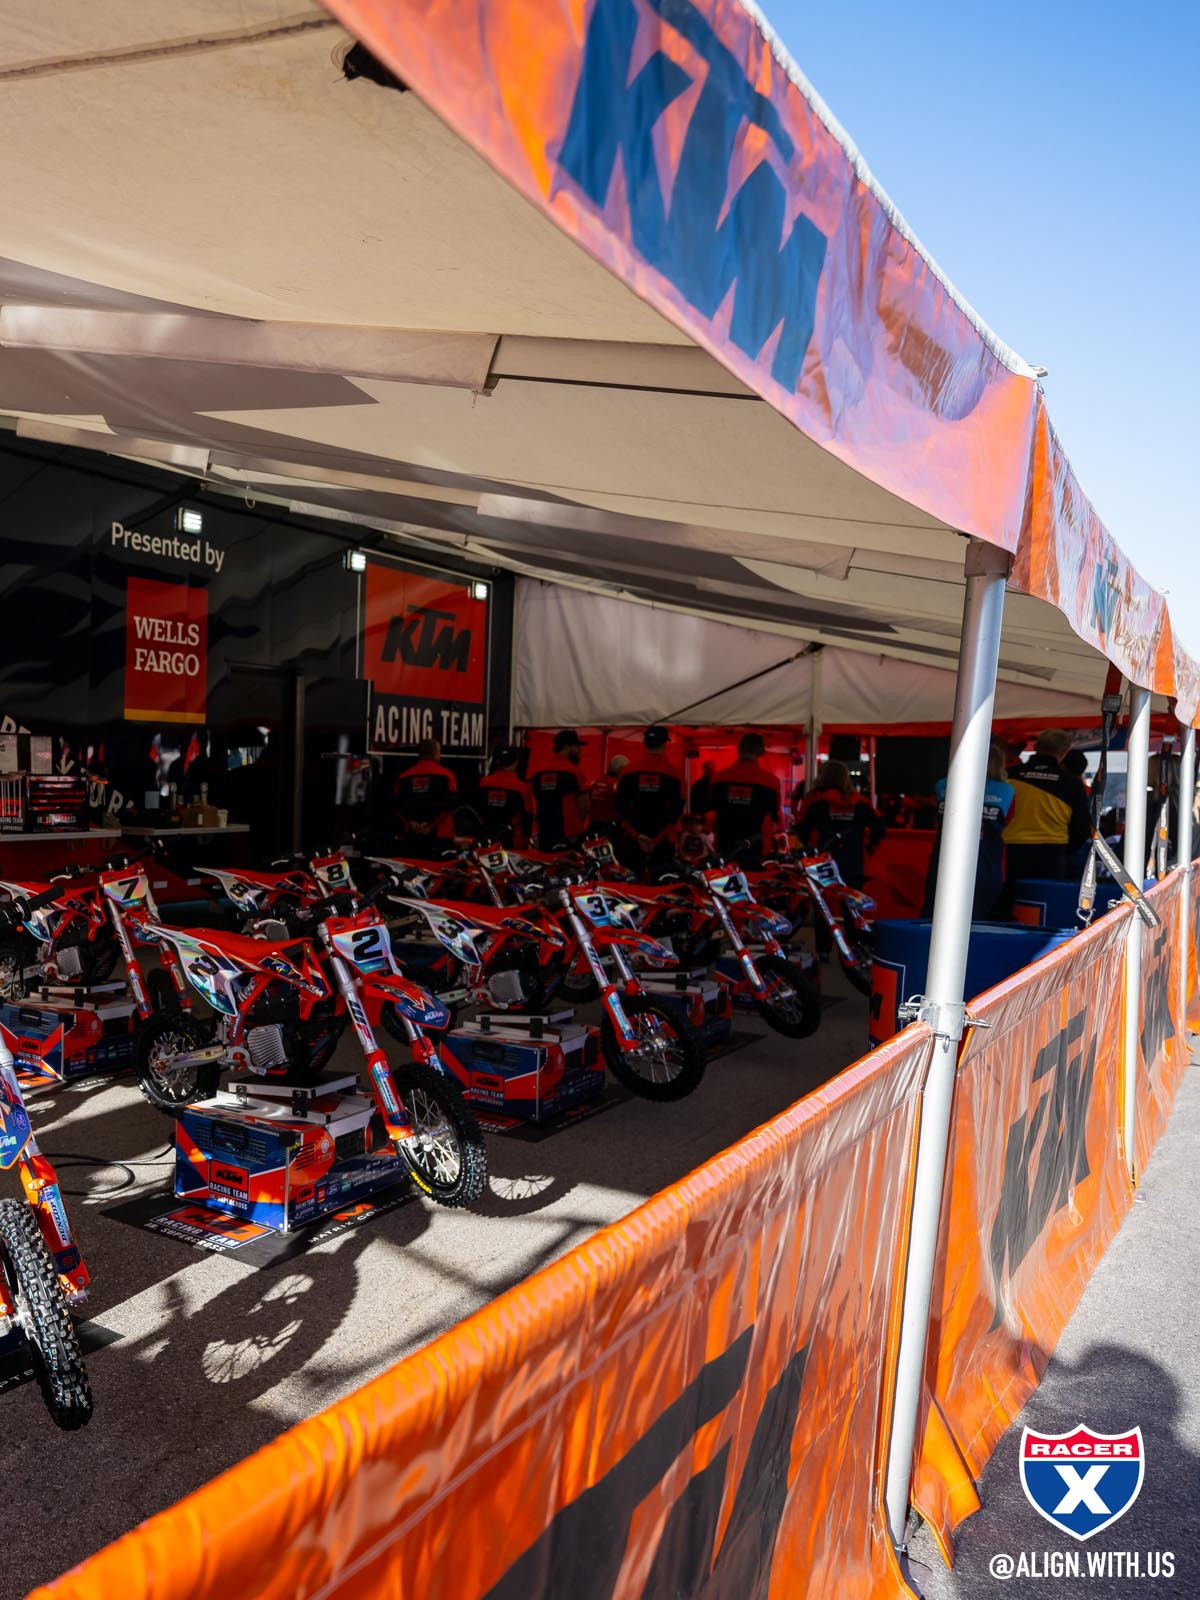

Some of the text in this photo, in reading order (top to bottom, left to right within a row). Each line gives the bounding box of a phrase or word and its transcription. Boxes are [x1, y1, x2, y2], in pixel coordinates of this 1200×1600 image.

[557, 0, 828, 395] KTM
[111, 521, 225, 572] Presented by
[133, 615, 199, 646] WELLS
[381, 605, 472, 672] KTM
[134, 648, 199, 676] FARGO
[374, 705, 484, 747] ACING TEAM
[488, 853, 504, 867] 9
[592, 845, 611, 859] 10
[327, 864, 344, 881] 8
[816, 864, 834, 880] 5
[118, 877, 139, 900] 7
[723, 876, 742, 894] 4
[587, 896, 605, 917] 3
[352, 929, 383, 961] 2
[216, 1169, 242, 1185] KTM
[210, 1182, 248, 1201] RACING TEAM
[217, 1196, 248, 1211] SUPERCROSS
[51, 1201, 67, 1241] DUNLOP
[157, 1217, 241, 1248] RACING TEAM
[308, 1221, 354, 1243] MATRIX
[161, 1227, 226, 1252] SUPERCROSS
